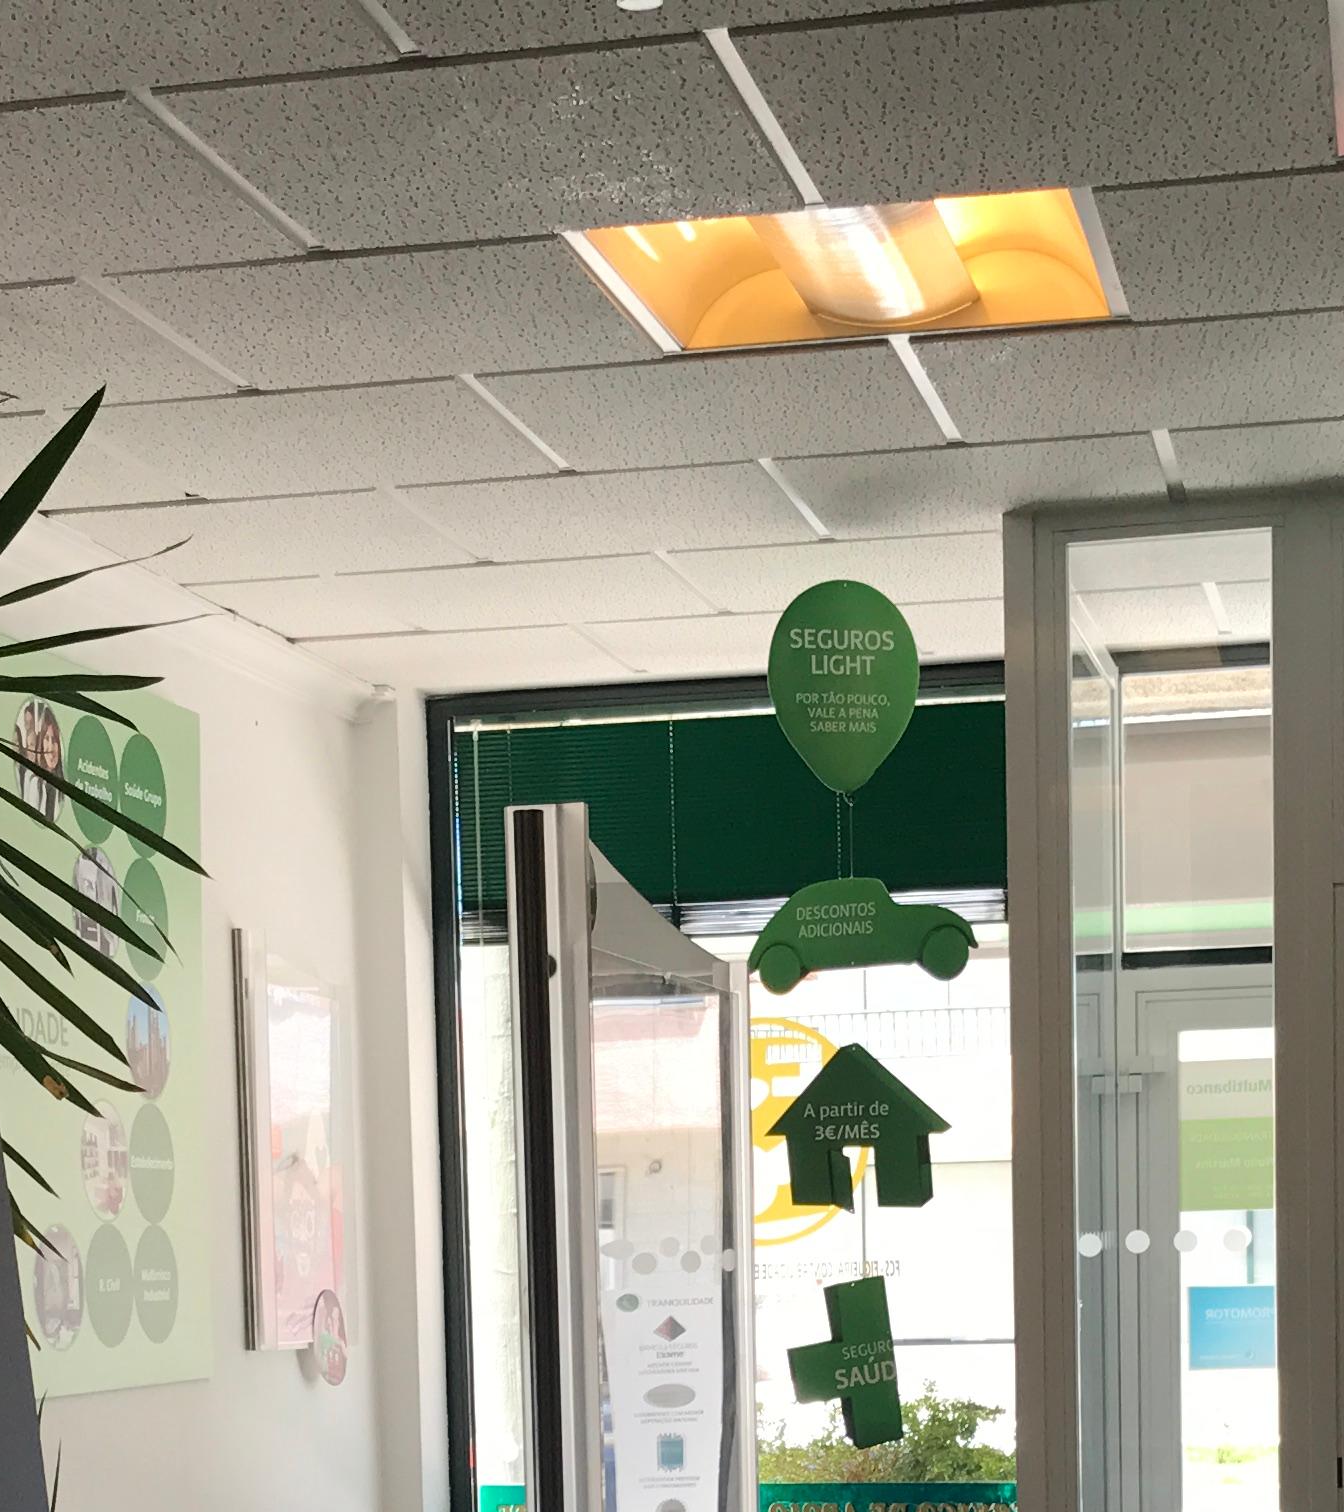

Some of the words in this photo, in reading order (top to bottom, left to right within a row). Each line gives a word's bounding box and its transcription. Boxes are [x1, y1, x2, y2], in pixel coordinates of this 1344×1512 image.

[789, 628, 895, 651] SEGUROS
[811, 654, 876, 675] LIGHT
[796, 692, 819, 704] POR
[822, 690, 845, 704] TÃO
[847, 693, 891, 707] POUCO,
[807, 707, 836, 718] VALE
[838, 707, 847, 718] A
[849, 707, 879, 719] PENA
[809, 721, 846, 733] SABER
[849, 721, 877, 733] MAIS
[796, 901, 877, 921] DESCONTOS
[798, 920, 874, 939] ADICIONAIS
[803, 1103, 816, 1118] A
[819, 1101, 865, 1121] partir
[869, 1100, 889, 1116] de
[814, 1120, 880, 1141] 3€/MÊS
[834, 1355, 897, 1390] SAÚD
